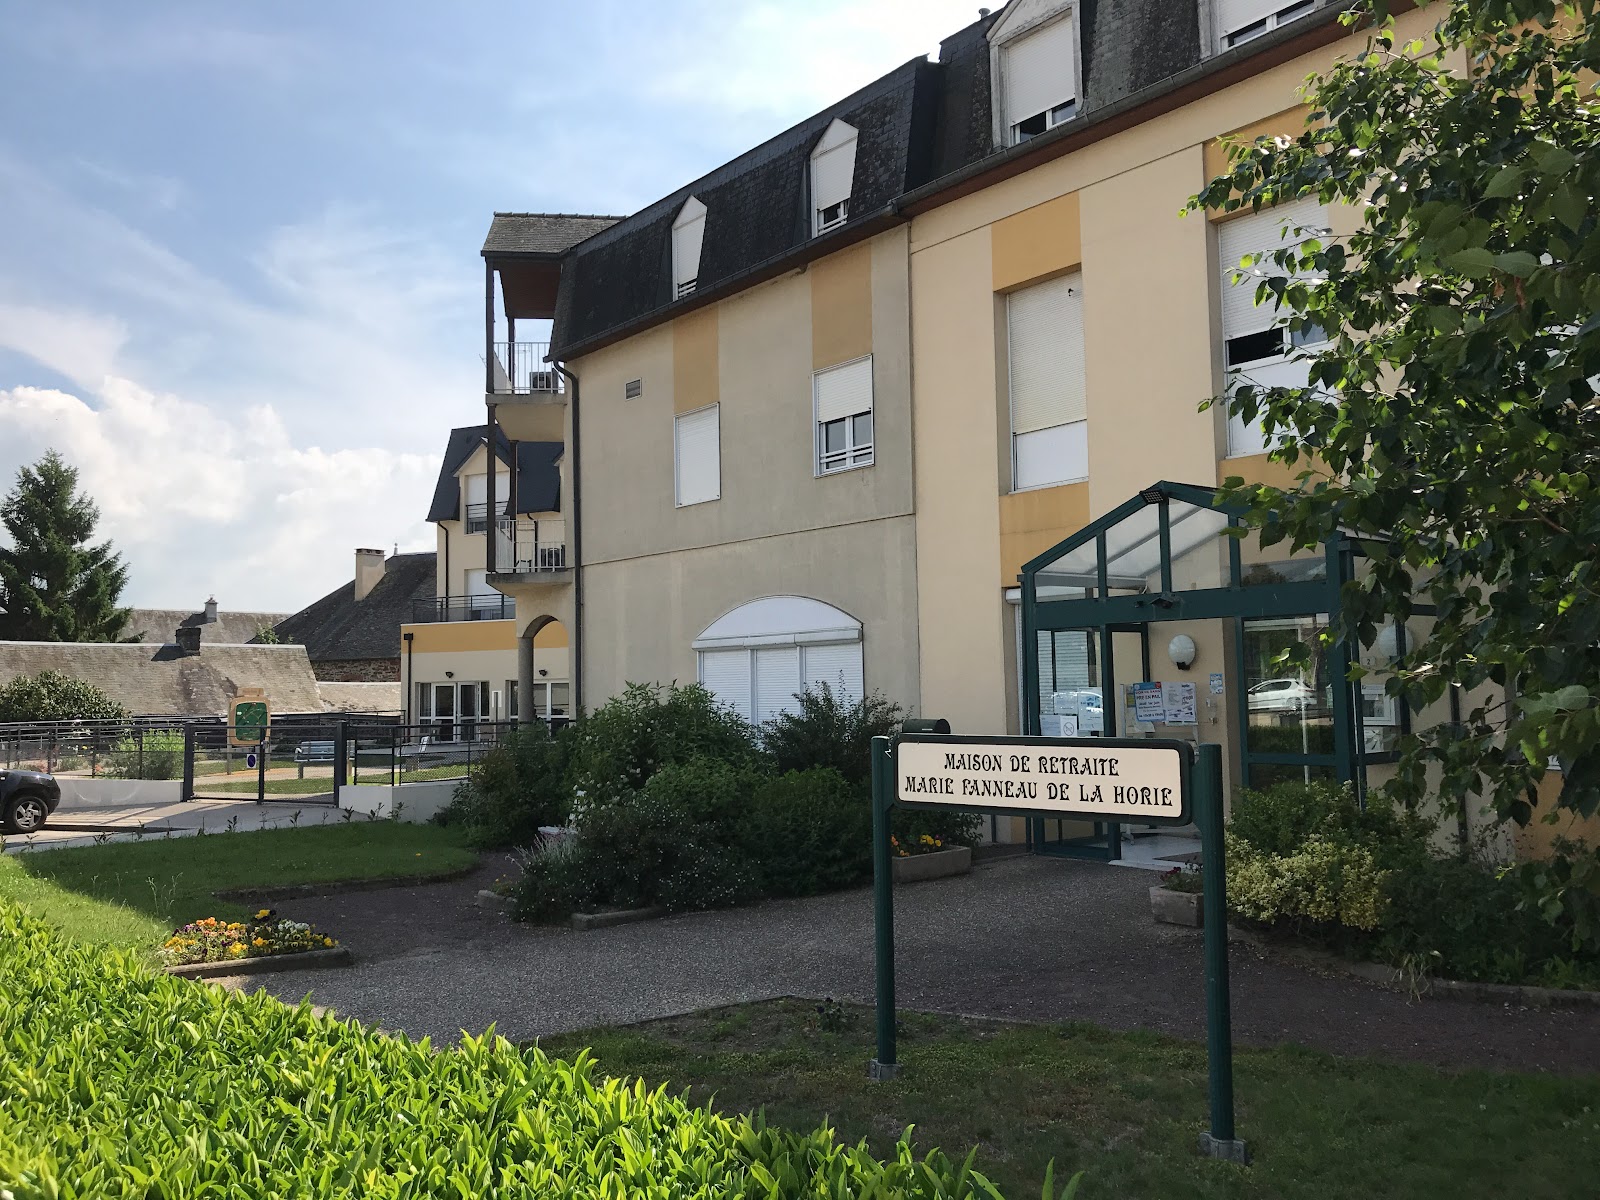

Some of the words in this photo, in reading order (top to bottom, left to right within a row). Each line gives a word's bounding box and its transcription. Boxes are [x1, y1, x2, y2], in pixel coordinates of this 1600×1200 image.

[944, 753, 1002, 772] MAISON
[1010, 754, 1031, 773] DE
[1038, 756, 1120, 776] RETRAITE
[905, 775, 955, 795] MARIE
[962, 778, 1038, 799] FANNEAU
[1046, 782, 1070, 801] DE
[1079, 784, 1104, 803] LA
[1113, 785, 1173, 807] HORIE
